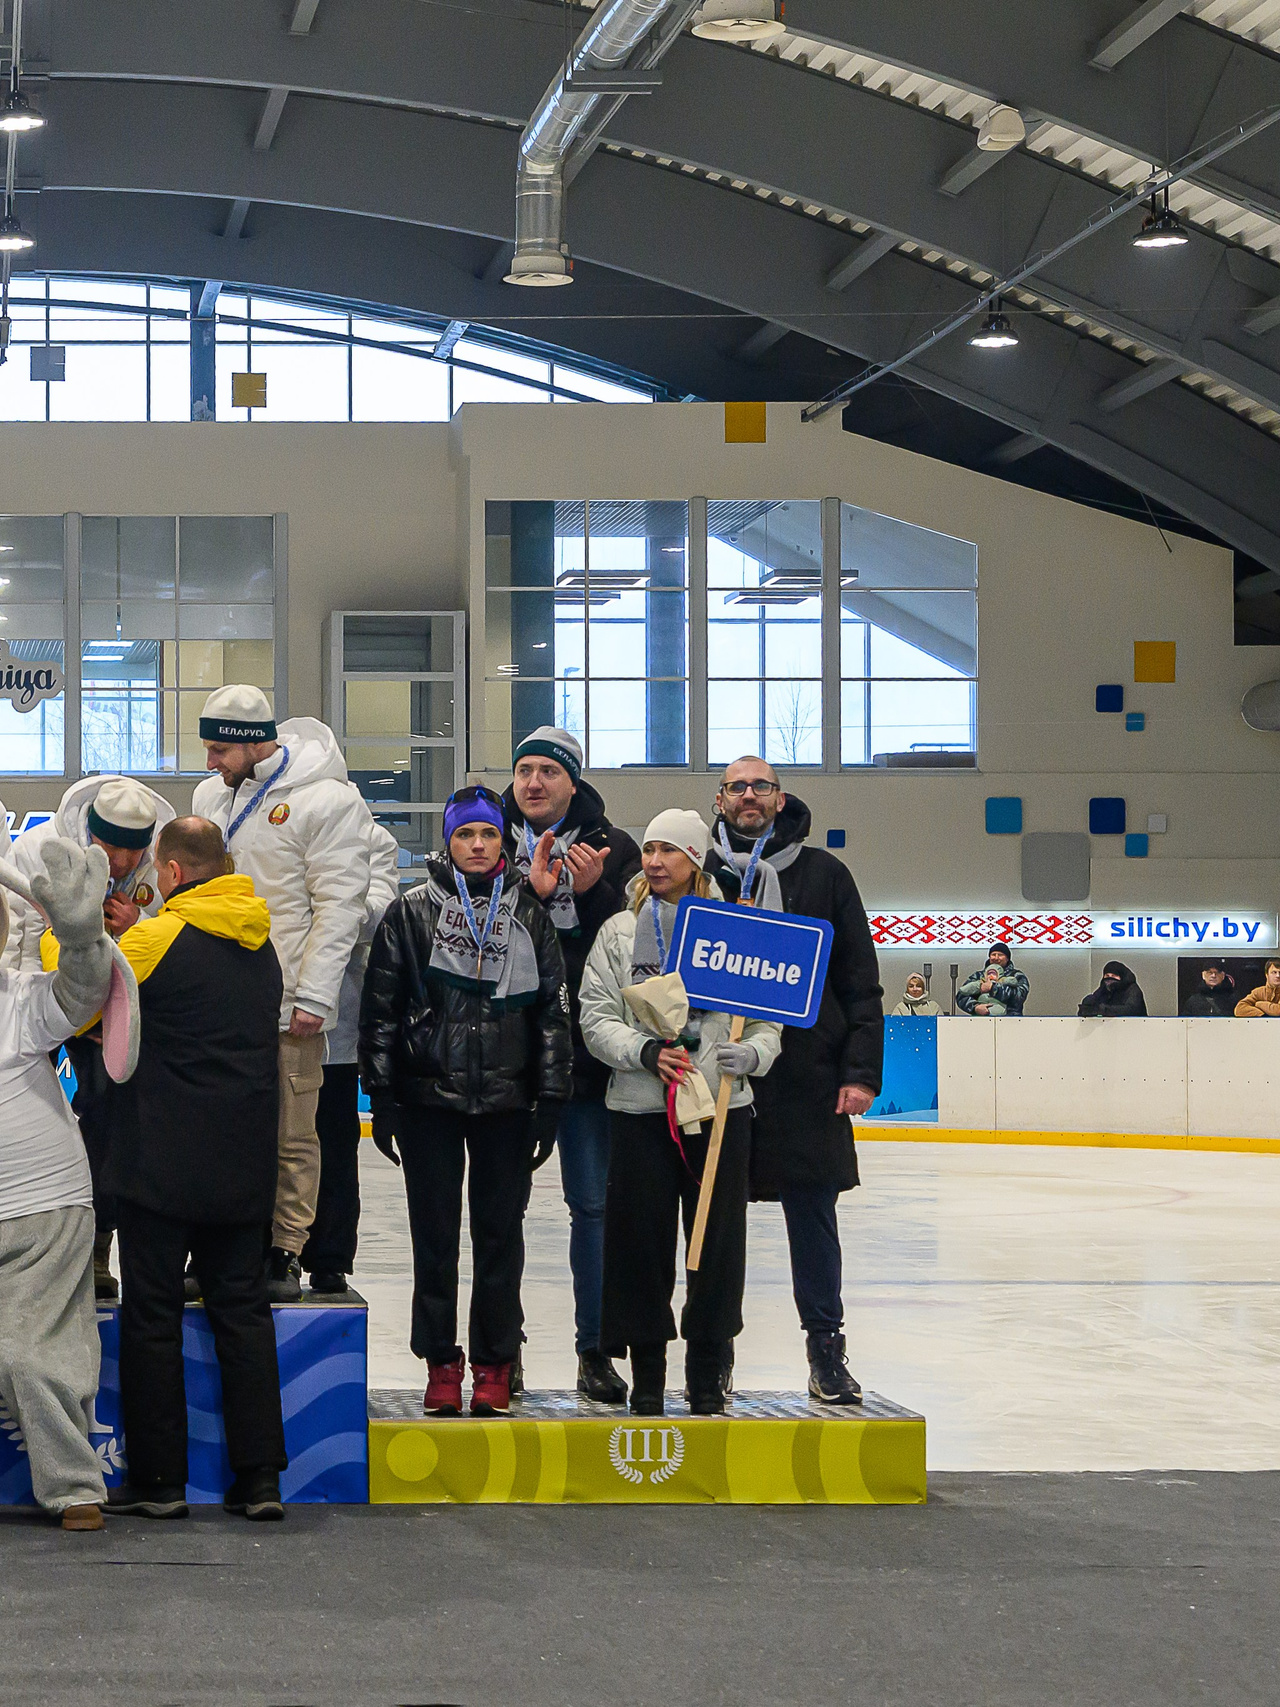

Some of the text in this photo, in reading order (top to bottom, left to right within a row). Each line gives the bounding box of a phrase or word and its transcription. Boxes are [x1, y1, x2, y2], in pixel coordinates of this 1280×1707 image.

[219, 726, 266, 737] БЕЛАРУСЬ
[1111, 917, 1261, 942] silichy.by
[692, 938, 801, 985] Единые
[621, 1429, 673, 1462] III
